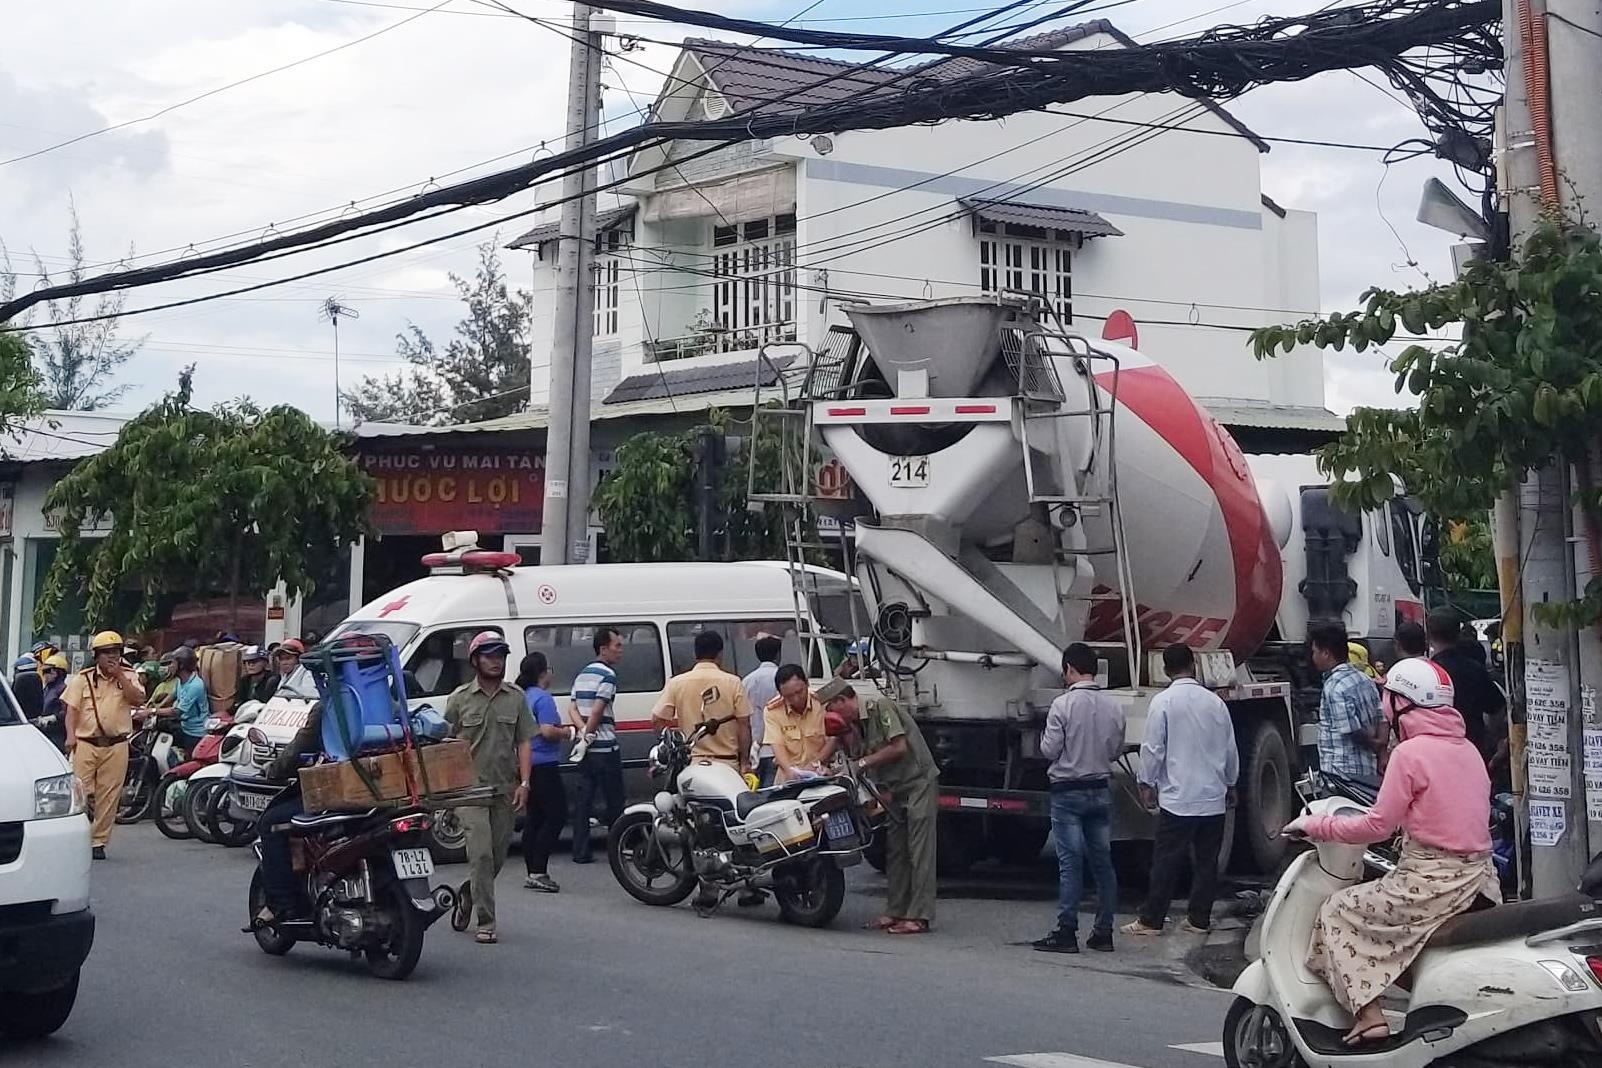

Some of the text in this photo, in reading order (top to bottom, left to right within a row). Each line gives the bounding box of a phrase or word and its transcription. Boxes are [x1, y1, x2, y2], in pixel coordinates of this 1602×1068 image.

[462, 455, 500, 469] MAI
[892, 461, 927, 481] 214
[467, 473, 520, 510] LỢI
[1553, 787, 1569, 796] 358
